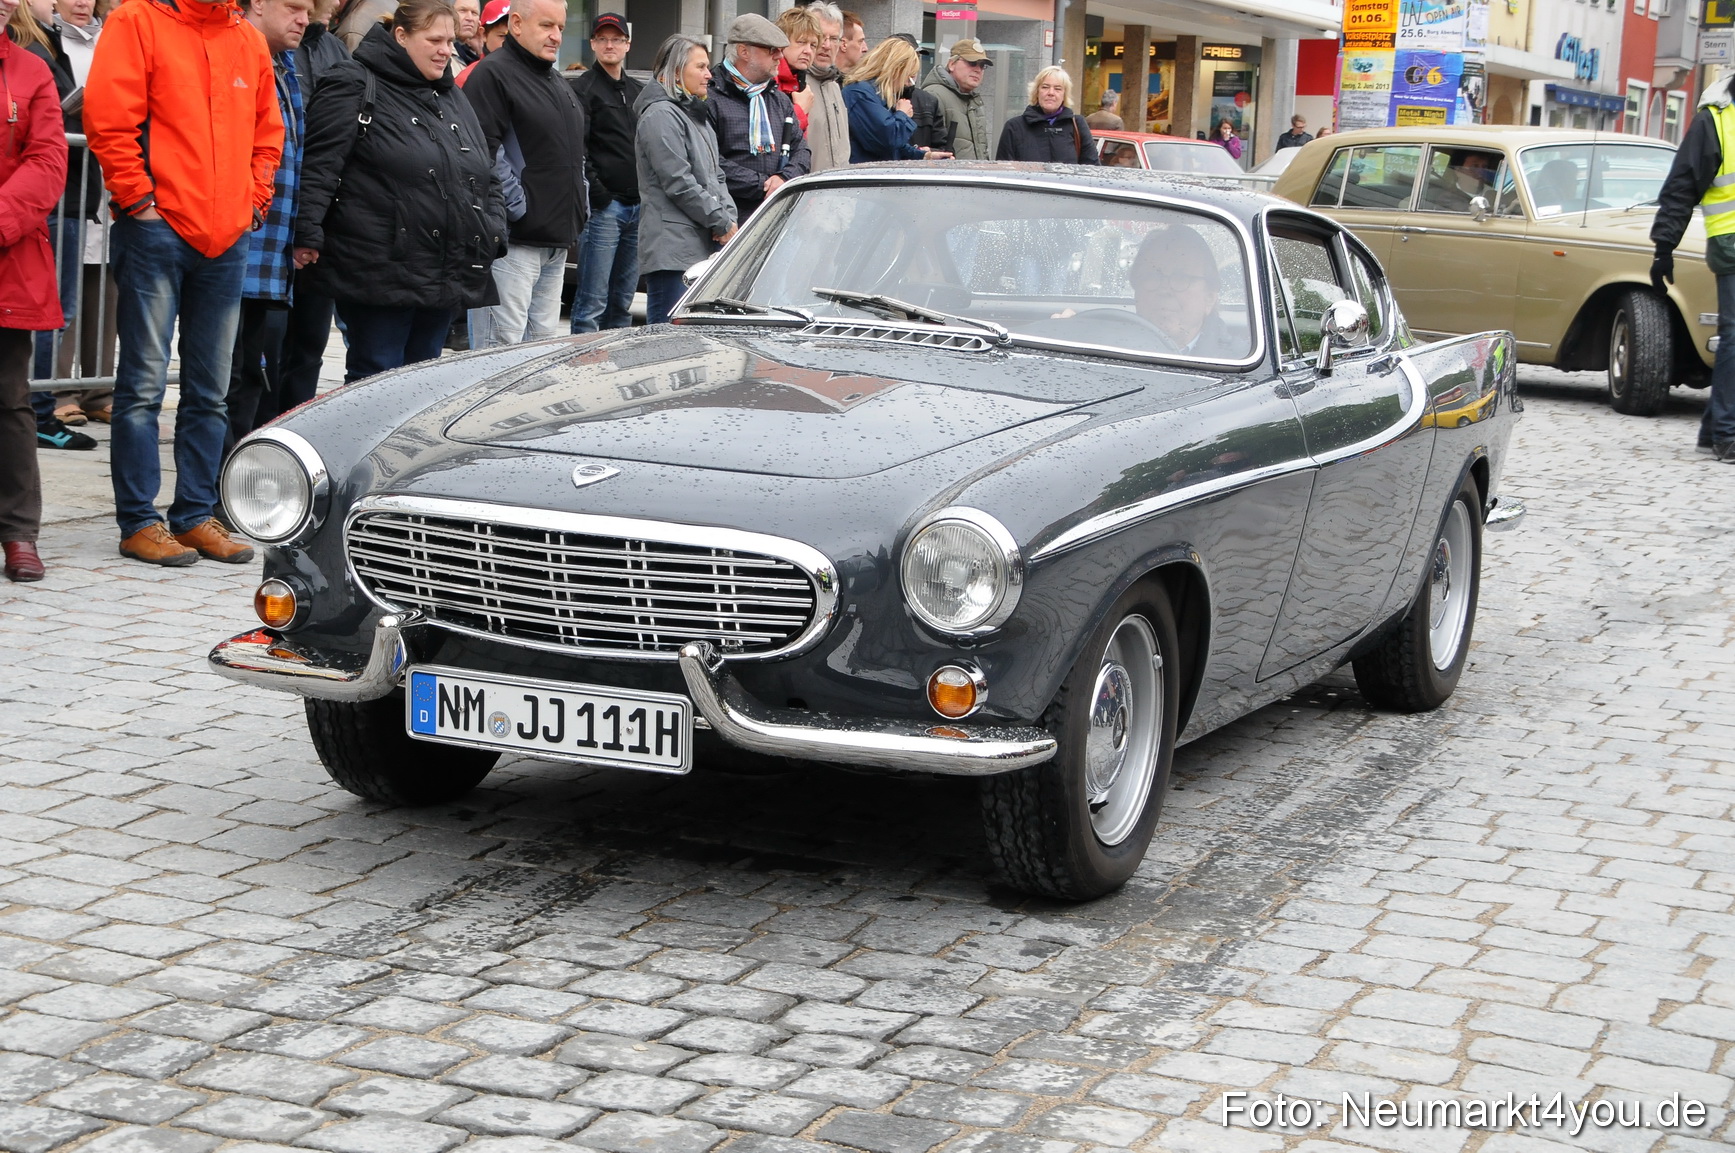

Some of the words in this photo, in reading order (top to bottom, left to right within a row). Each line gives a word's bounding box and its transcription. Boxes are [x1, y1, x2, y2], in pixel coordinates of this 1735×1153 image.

[1351, 3, 1389, 11] Samstag
[1351, 14, 1386, 23] 01.06.
[1426, 9, 1449, 24] OPEN
[1451, 5, 1461, 15] AIR
[1345, 32, 1392, 41] Volksfestplatz
[1400, 28, 1426, 37] 25.6.
[1202, 46, 1242, 58] FRIES
[1404, 66, 1443, 85] G6
[1399, 109, 1421, 117] Metal
[1423, 110, 1444, 118] Night
[419, 709, 429, 723] D
[438, 682, 485, 734] NM
[516, 694, 565, 744] JJ
[576, 701, 680, 758] 111H
